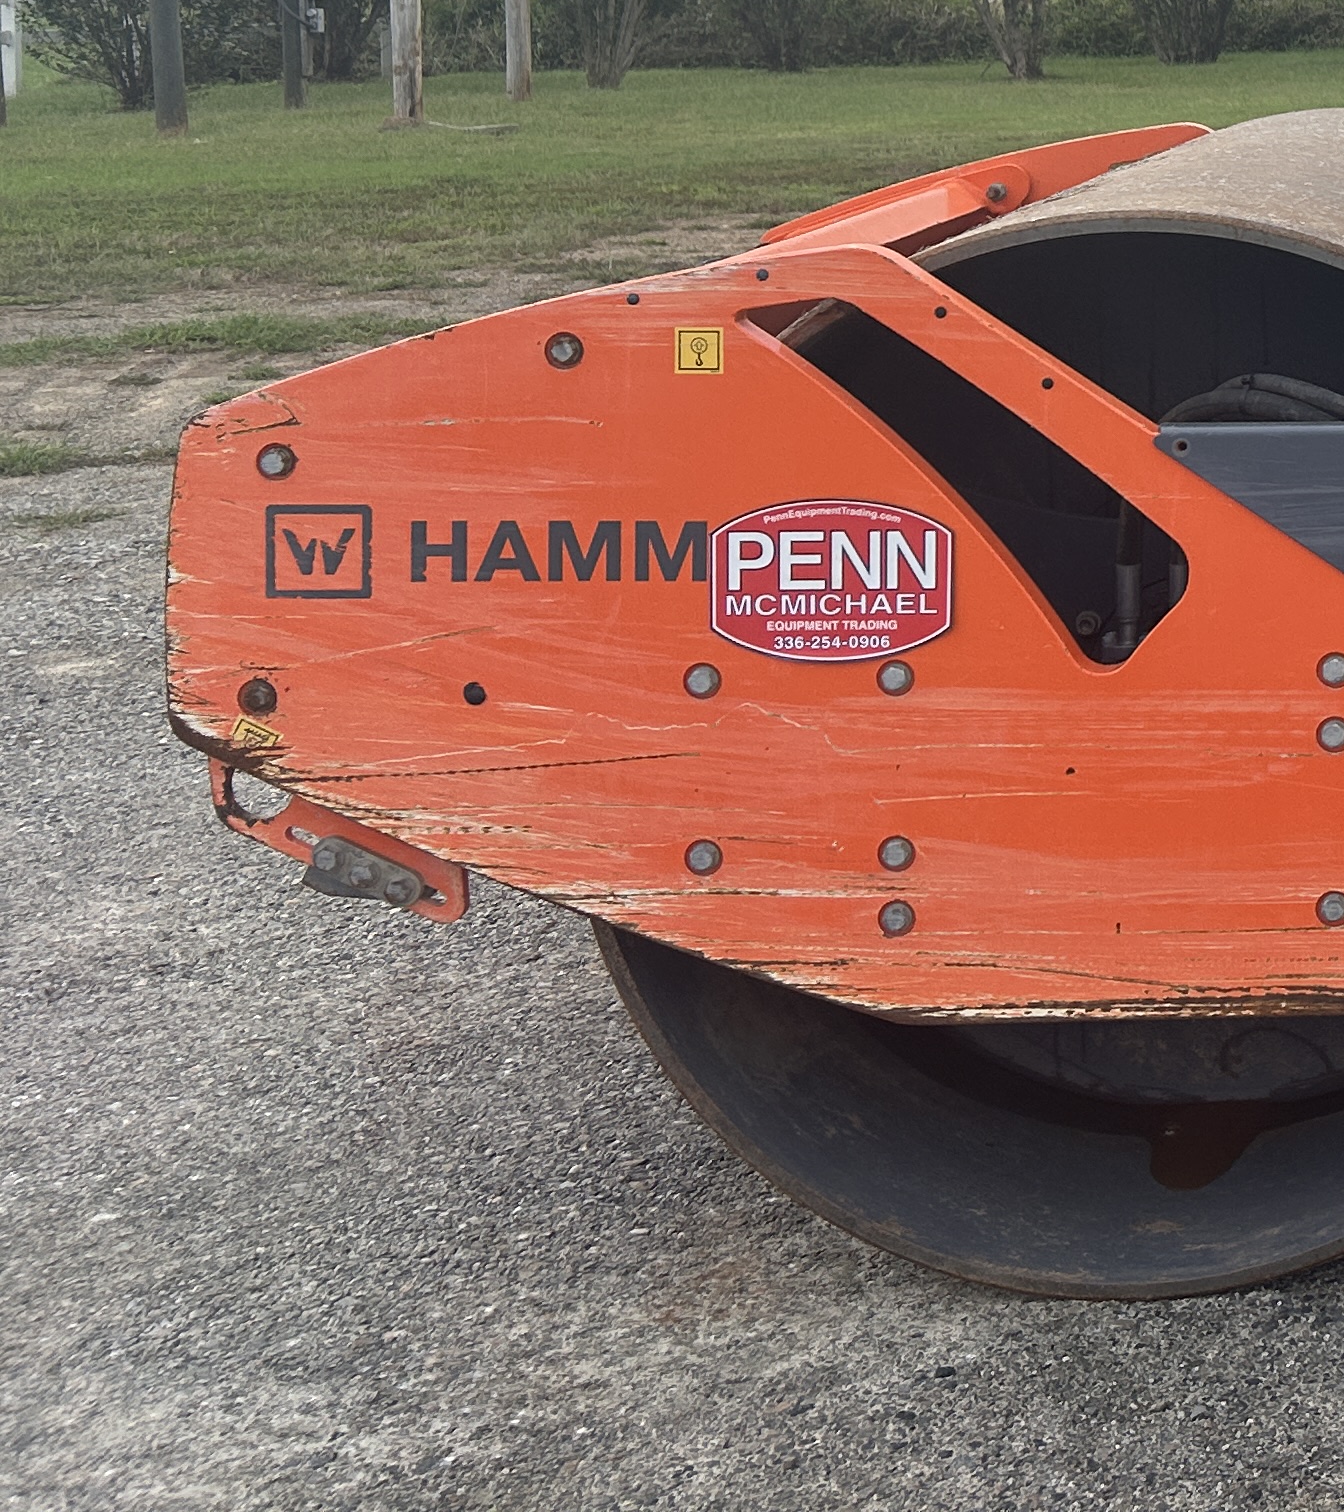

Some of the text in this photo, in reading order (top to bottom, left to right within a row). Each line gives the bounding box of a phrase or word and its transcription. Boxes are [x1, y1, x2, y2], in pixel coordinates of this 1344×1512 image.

[763, 506, 902, 524] PennEquipmentTrading.com
[410, 519, 709, 583] HAMM
[727, 530, 938, 591] PENN
[725, 593, 938, 616] MCMICHAEL
[766, 619, 898, 631] EQUIPMENT TRADING
[773, 635, 891, 650] 336-254-0906
